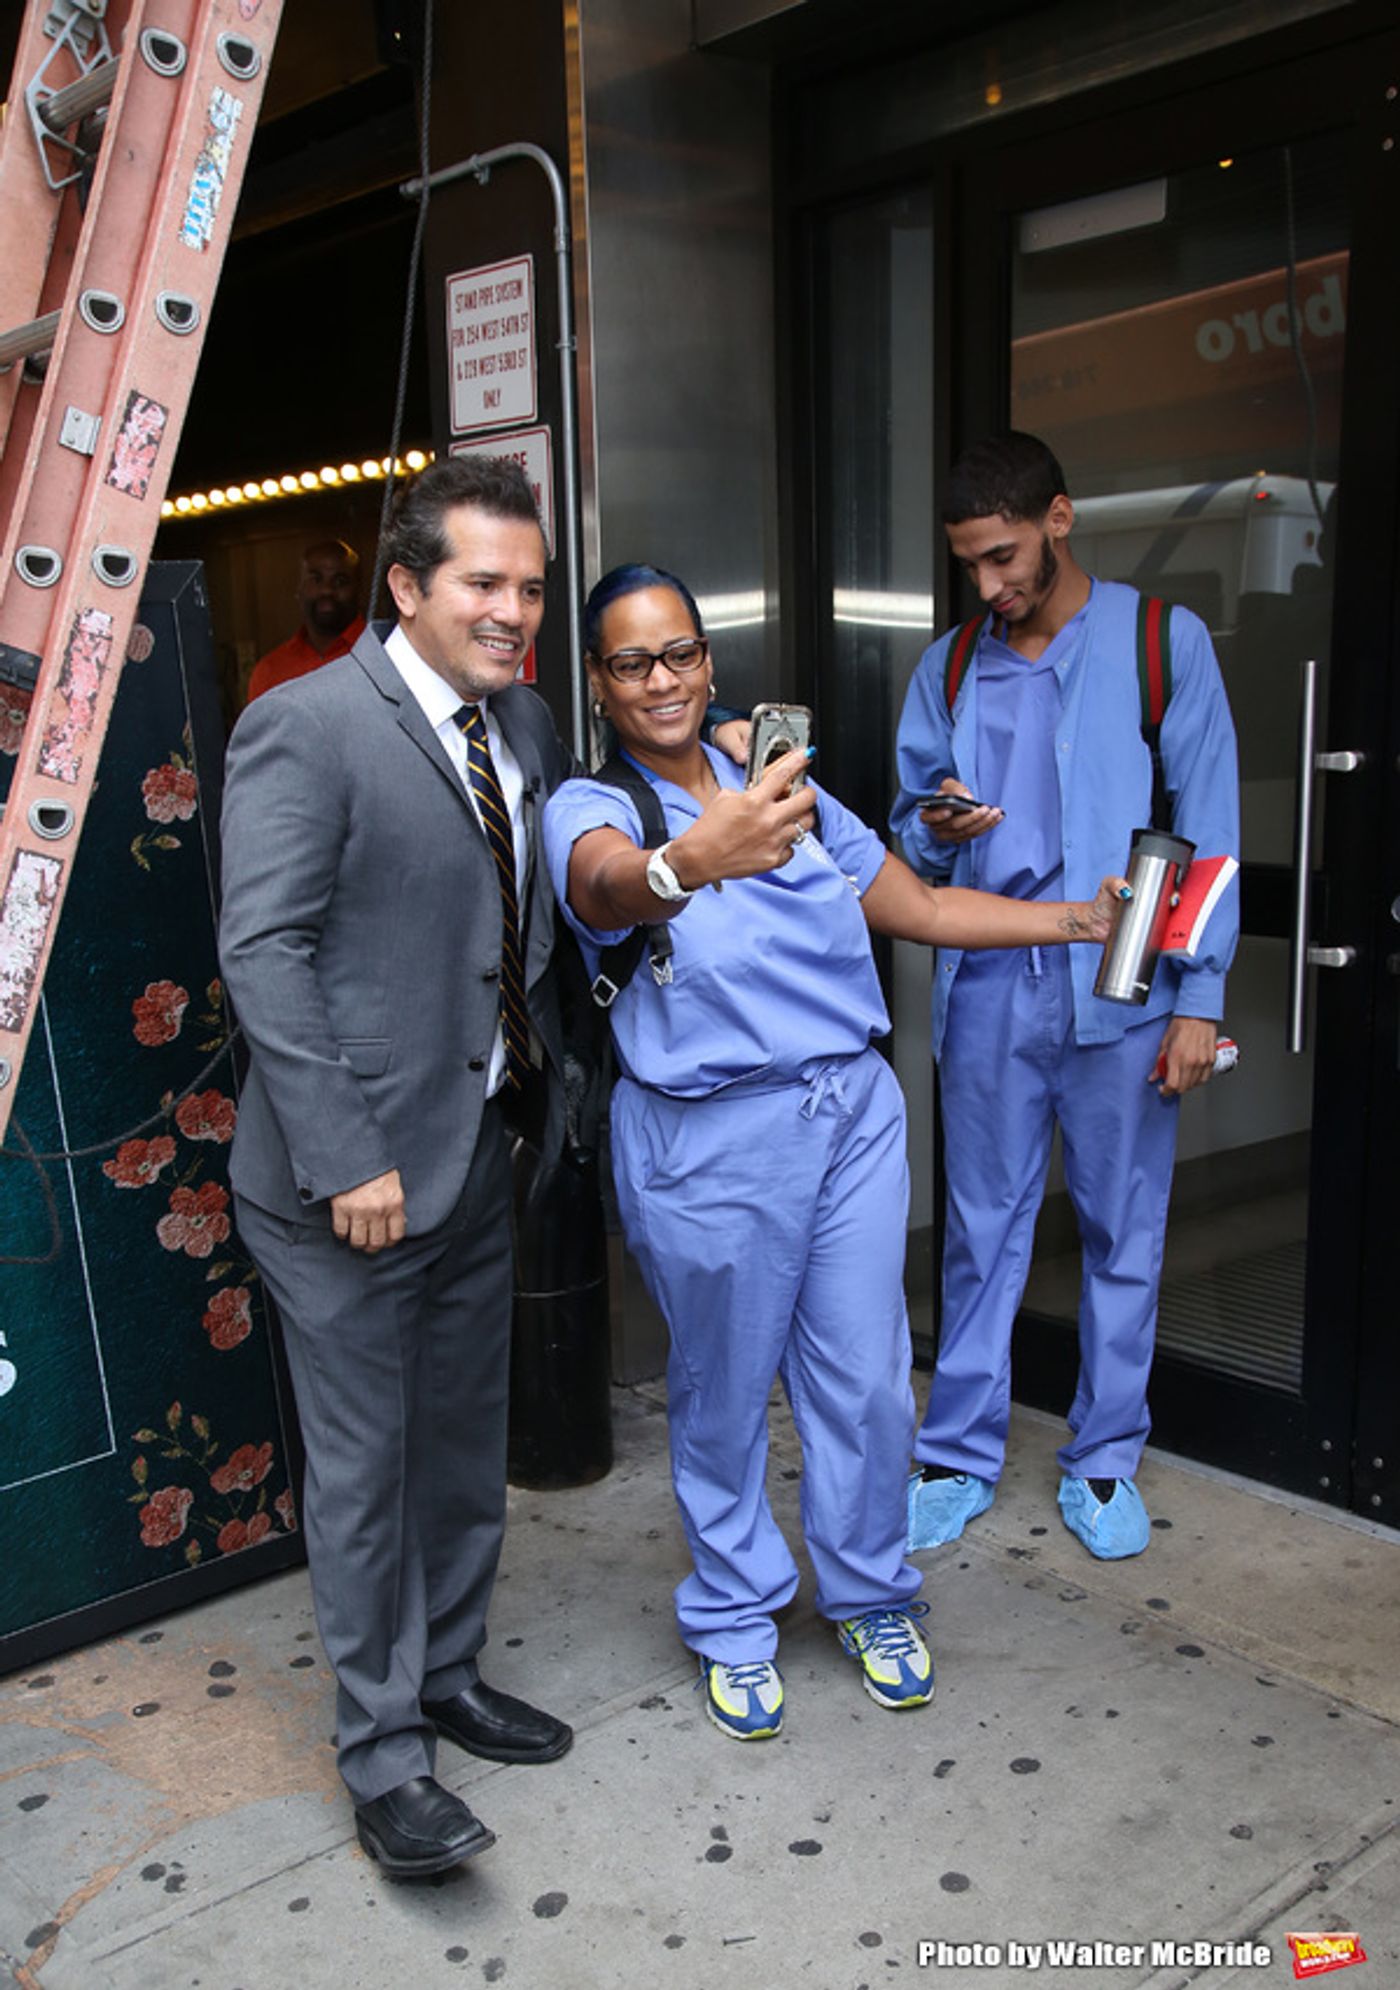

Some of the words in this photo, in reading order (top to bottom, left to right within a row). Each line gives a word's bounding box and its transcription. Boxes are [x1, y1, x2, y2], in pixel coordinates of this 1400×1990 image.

[455, 290, 477, 313] STAND
[478, 285, 494, 306] PIPE
[495, 279, 523, 304] SYSTEM
[451, 328, 465, 348] FOR
[466, 324, 480, 345] 254
[481, 319, 499, 342] WEST
[501, 315, 519, 338] 54TH
[520, 312, 529, 333] ST
[478, 354, 496, 376] WEST
[518, 347, 527, 368] ST
[483, 388, 501, 409] ONLY
